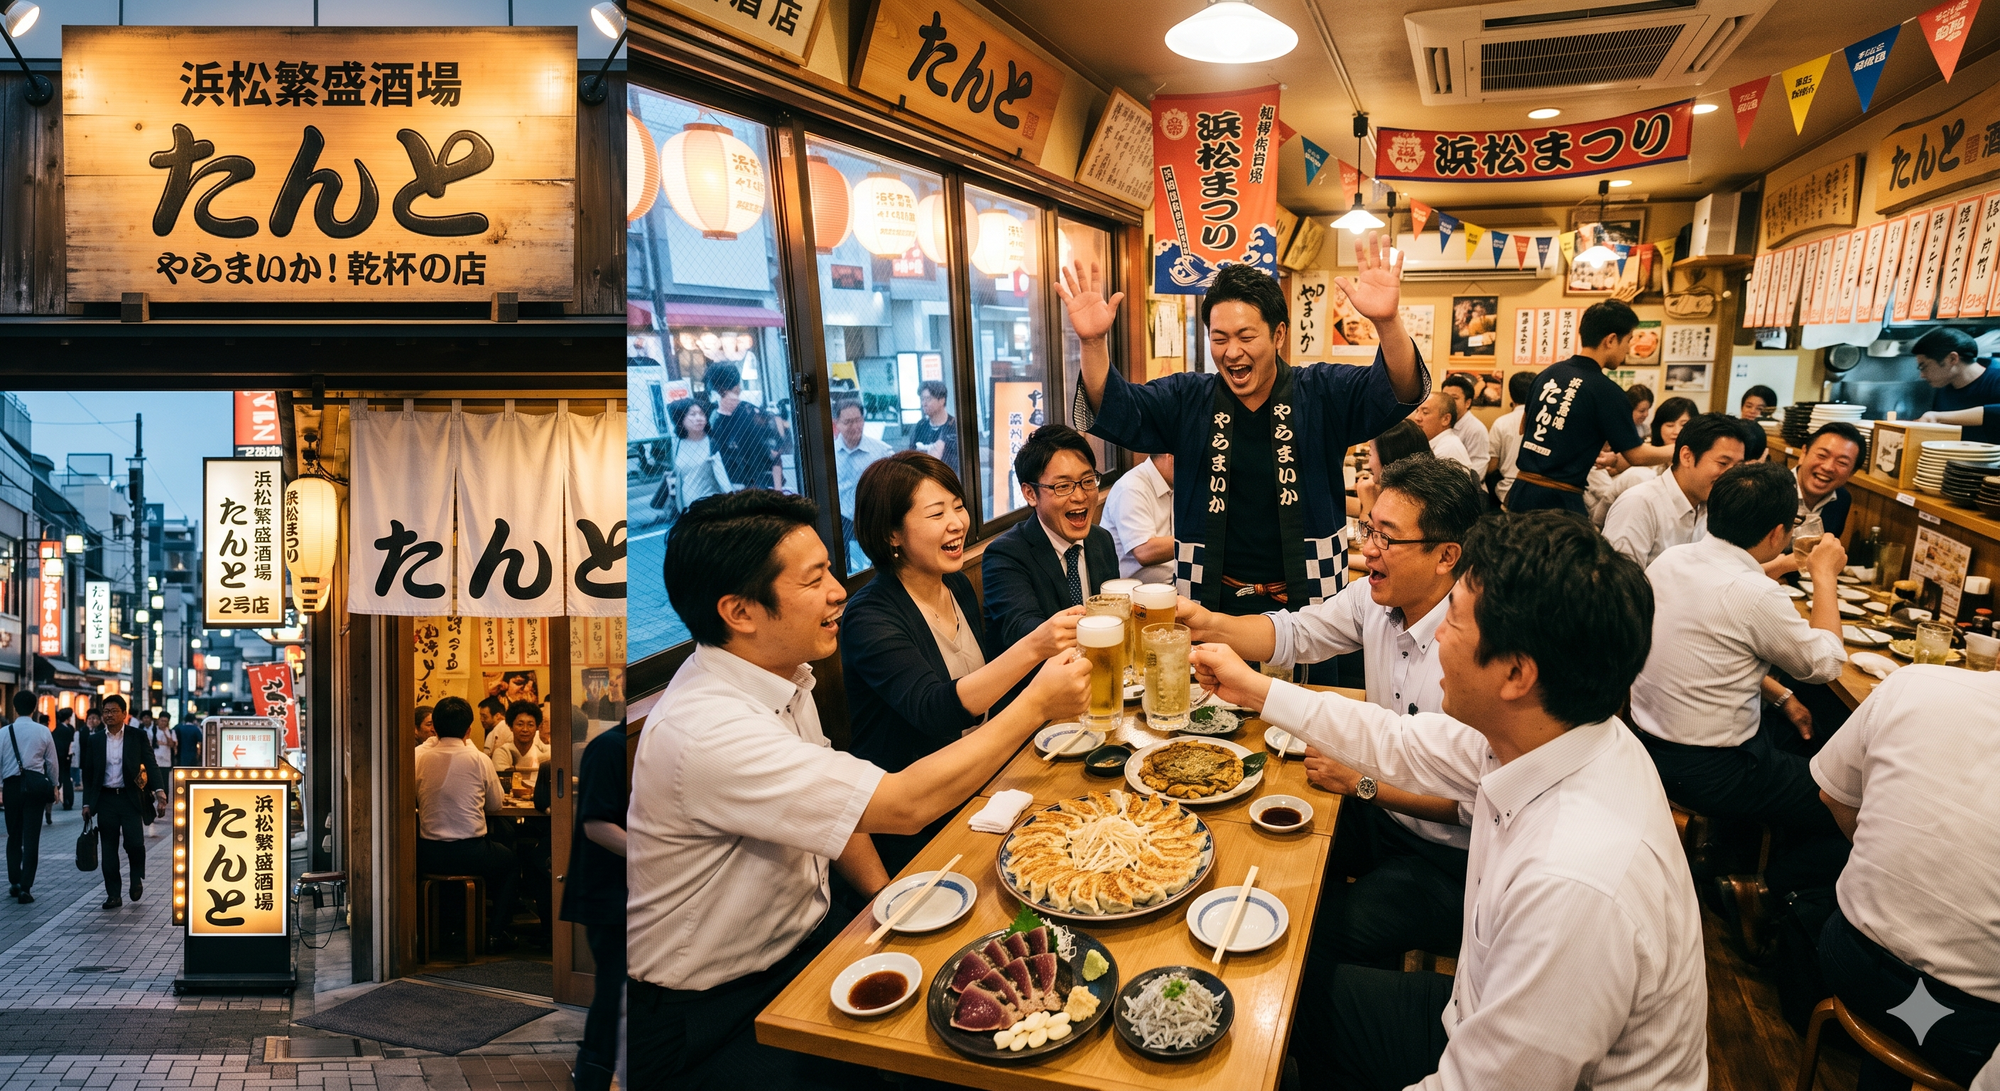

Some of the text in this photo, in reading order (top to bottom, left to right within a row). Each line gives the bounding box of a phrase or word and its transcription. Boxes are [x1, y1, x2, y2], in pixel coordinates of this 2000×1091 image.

[179, 61, 462, 108] 浜松繁盛酒場
[908, 11, 1032, 129] たんと
[149, 123, 495, 239] たんと
[1197, 111, 1241, 249] 浜松まつり
[1434, 113, 1671, 175] 浜松まつり
[1889, 118, 1965, 191] たんと
[1273, 403, 1298, 506] やらまいか
[1533, 378, 1562, 442] たんと
[1208, 412, 1230, 513] やらまいか
[219, 497, 248, 589] たんと
[254, 470, 272, 581] 浜松繁盛酒場
[374, 518, 627, 600] たんと
[219, 596, 269, 614] 2号店
[203, 798, 247, 926] たんと
[255, 795, 274, 911] 浜松繁盛酒場
